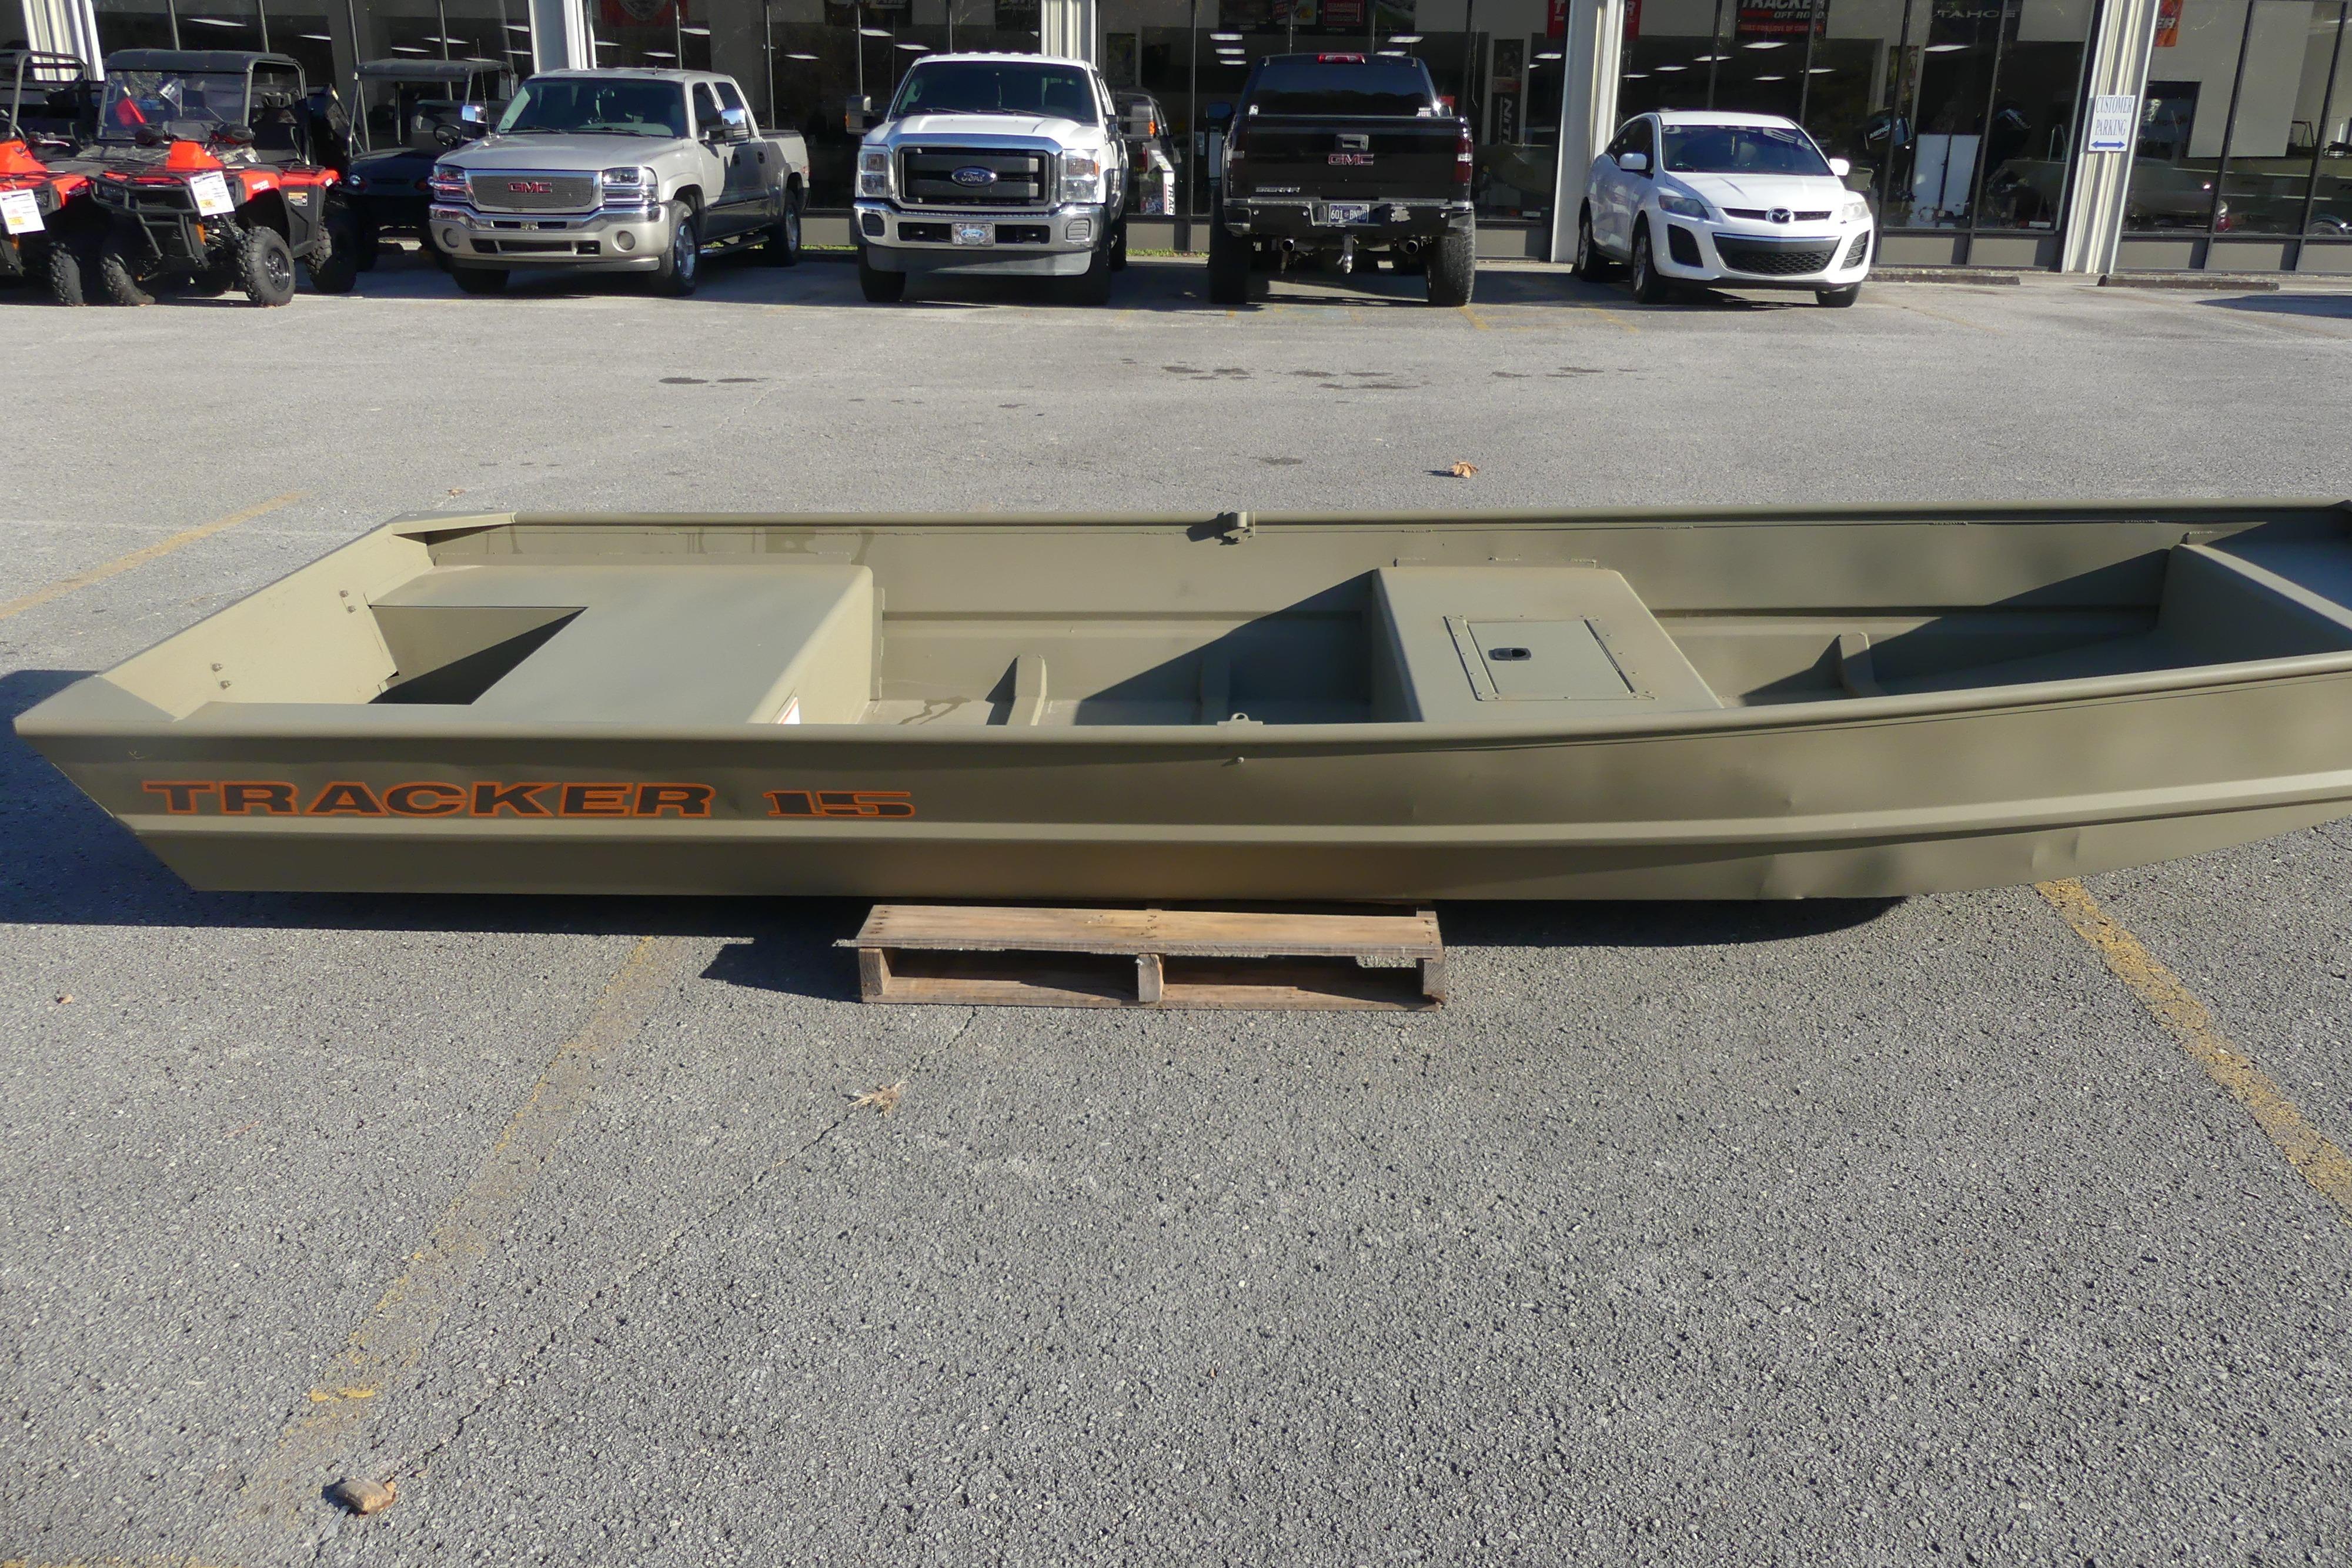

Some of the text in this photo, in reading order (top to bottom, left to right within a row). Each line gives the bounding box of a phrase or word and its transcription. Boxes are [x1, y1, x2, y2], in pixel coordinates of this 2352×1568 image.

[2095, 96, 2133, 113] CUSTOMER
[2094, 119, 2127, 136] PARKING
[1328, 153, 1374, 165] GMC
[961, 171, 985, 182] Ford
[508, 180, 552, 193] GMC
[1331, 209, 1344, 219] 601
[142, 780, 916, 818] TRACKER 15
